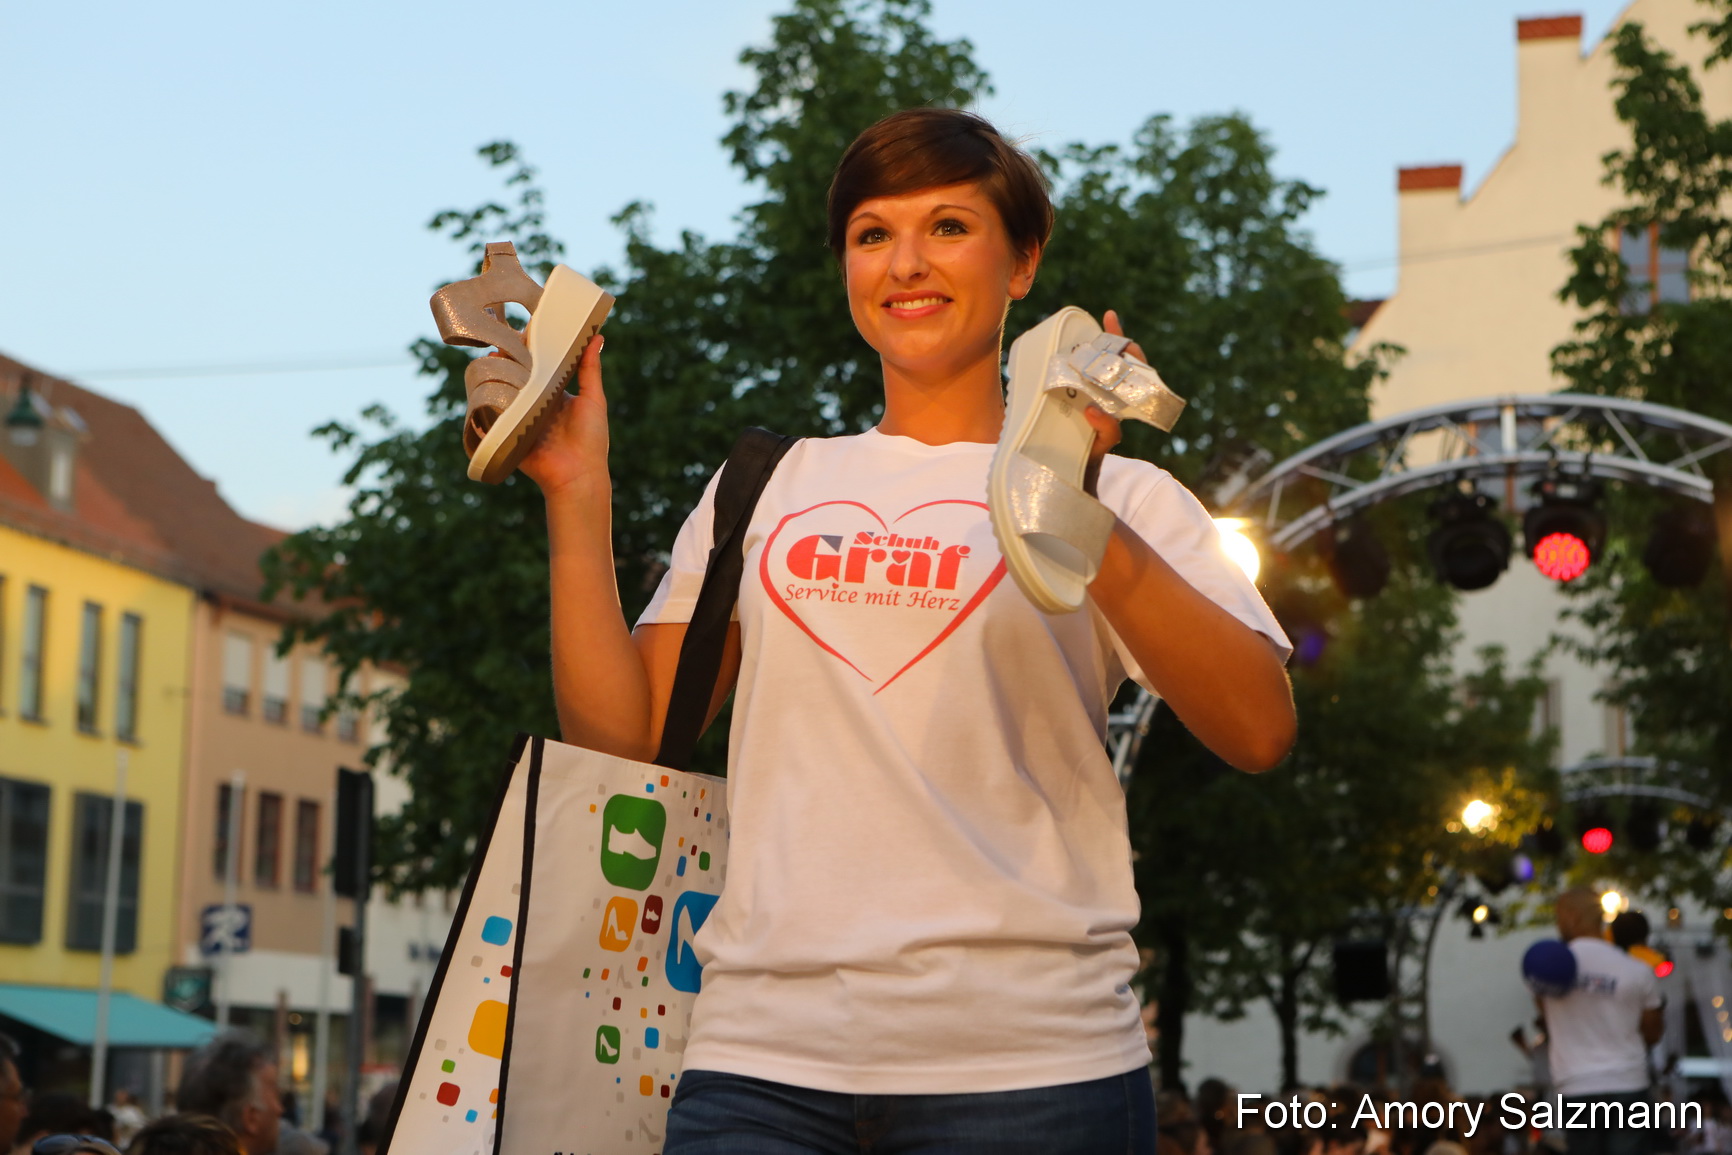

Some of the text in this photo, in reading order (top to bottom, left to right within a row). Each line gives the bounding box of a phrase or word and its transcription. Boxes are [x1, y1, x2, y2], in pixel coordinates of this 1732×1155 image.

[854, 531, 940, 551] Schuh
[785, 583, 961, 611] Service mit Herz
